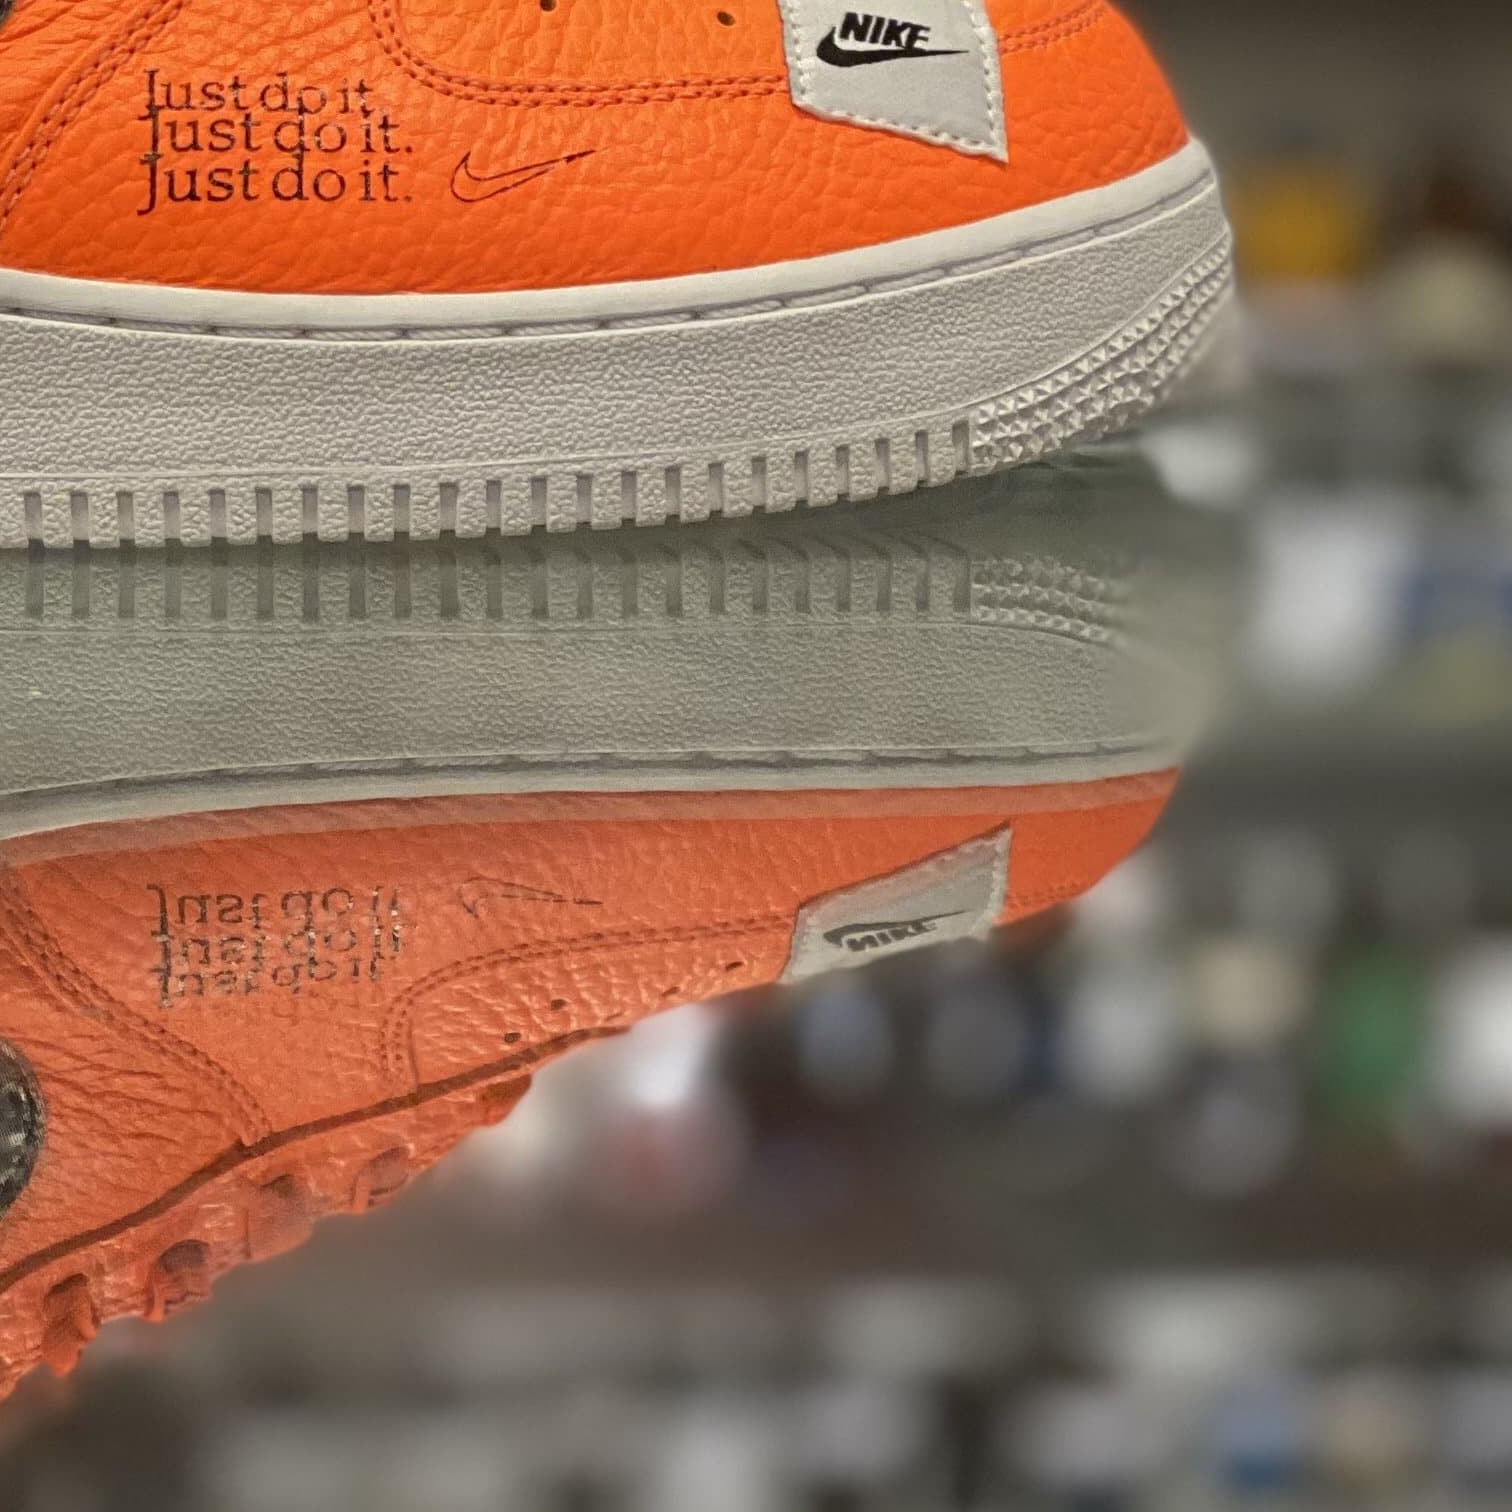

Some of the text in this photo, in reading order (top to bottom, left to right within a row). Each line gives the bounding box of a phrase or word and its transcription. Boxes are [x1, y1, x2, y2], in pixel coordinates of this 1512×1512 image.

[838, 11, 931, 51] NIKE
[138, 68, 250, 121] Just
[138, 104, 413, 164] Just do it.
[137, 150, 413, 216] Just do it.
